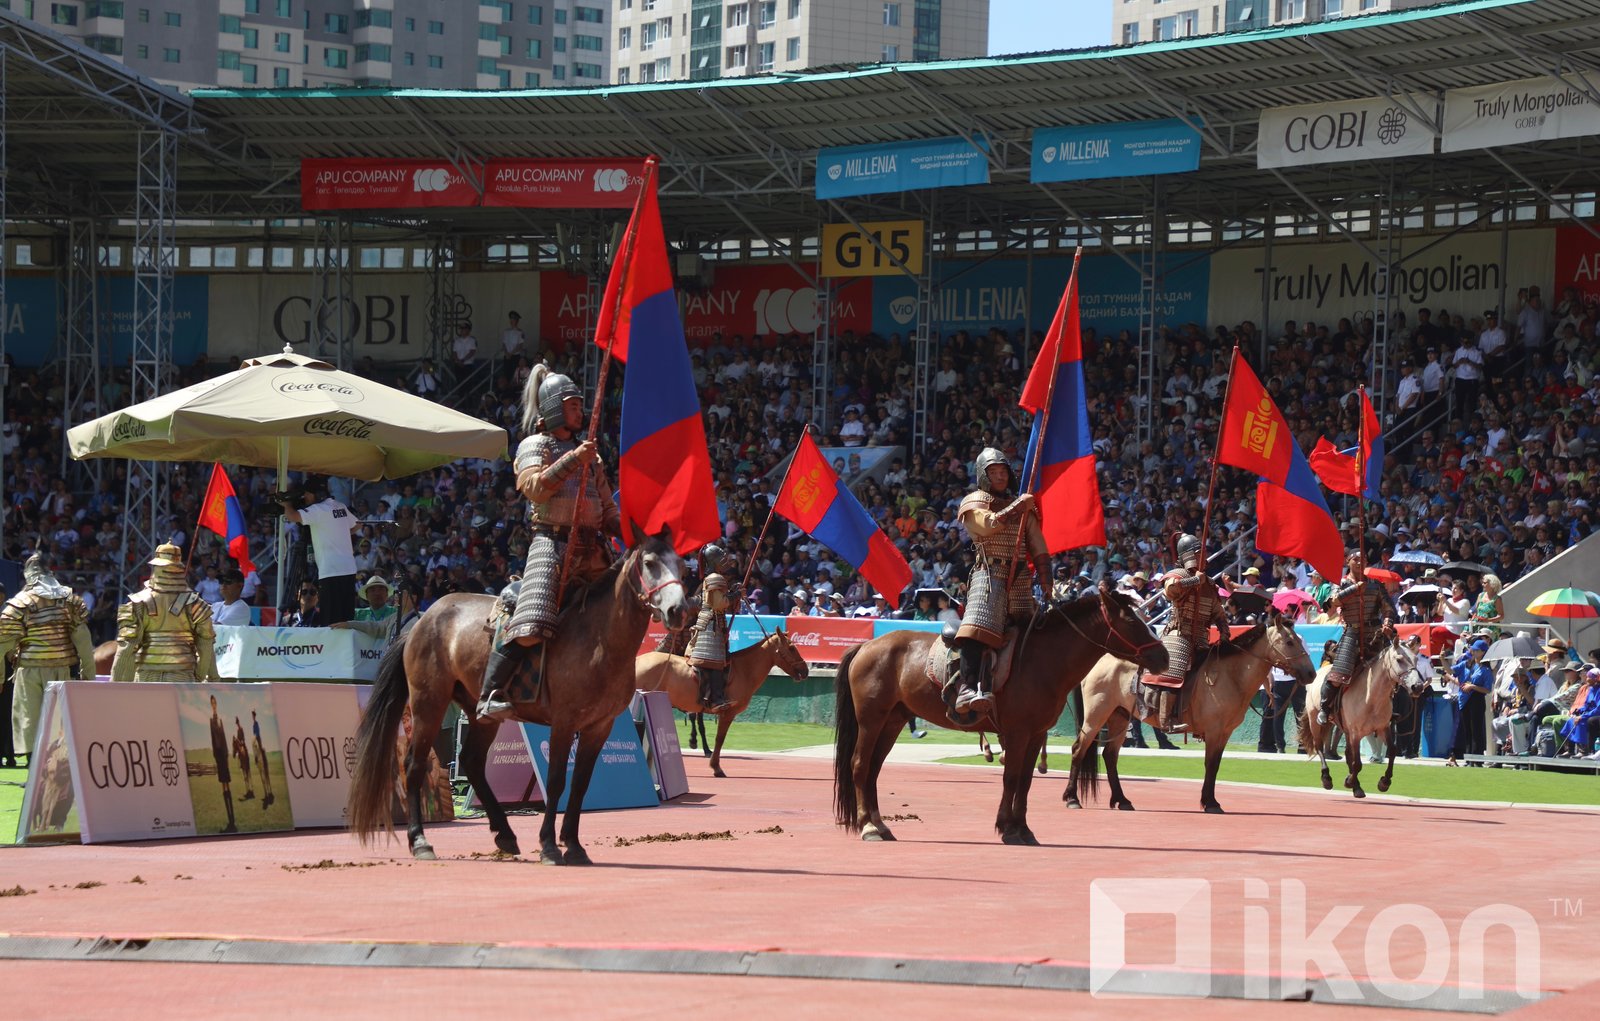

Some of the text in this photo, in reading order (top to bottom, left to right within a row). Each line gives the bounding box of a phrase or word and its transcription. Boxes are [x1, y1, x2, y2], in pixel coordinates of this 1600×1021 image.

[1473, 96, 1511, 120] Truly
[1284, 110, 1369, 154] GOBI
[1515, 116, 1538, 129] GOBI
[1059, 138, 1110, 162] MILLENIA
[315, 169, 408, 185] APU COMPANY
[495, 168, 585, 182] APU COMPANY
[844, 154, 898, 179] MILLENIA
[835, 229, 910, 268] G15
[1254, 263, 1332, 309] Truly
[677, 289, 741, 316] PANY
[930, 286, 1027, 322] MILLENIA
[273, 295, 410, 345] GOBI
[332, 508, 348, 519] CREW
[88, 740, 155, 790] GOBI
[287, 736, 340, 780] GOBI
